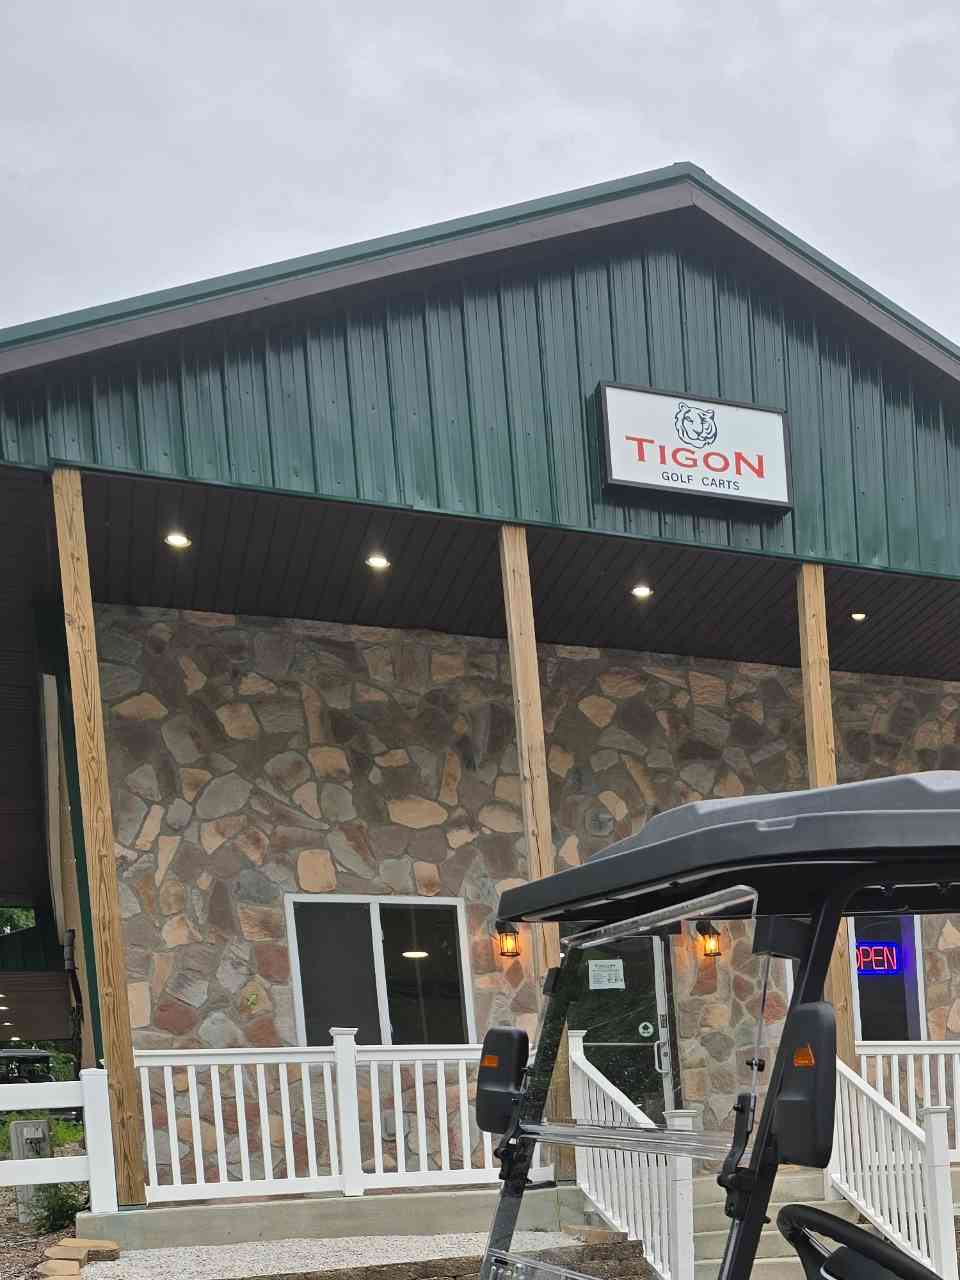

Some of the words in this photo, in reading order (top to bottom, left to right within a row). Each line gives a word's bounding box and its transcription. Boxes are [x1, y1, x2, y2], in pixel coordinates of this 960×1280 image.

[625, 435, 765, 479] TIGON
[661, 471, 694, 484] GOLF
[701, 476, 741, 491] CARTS
